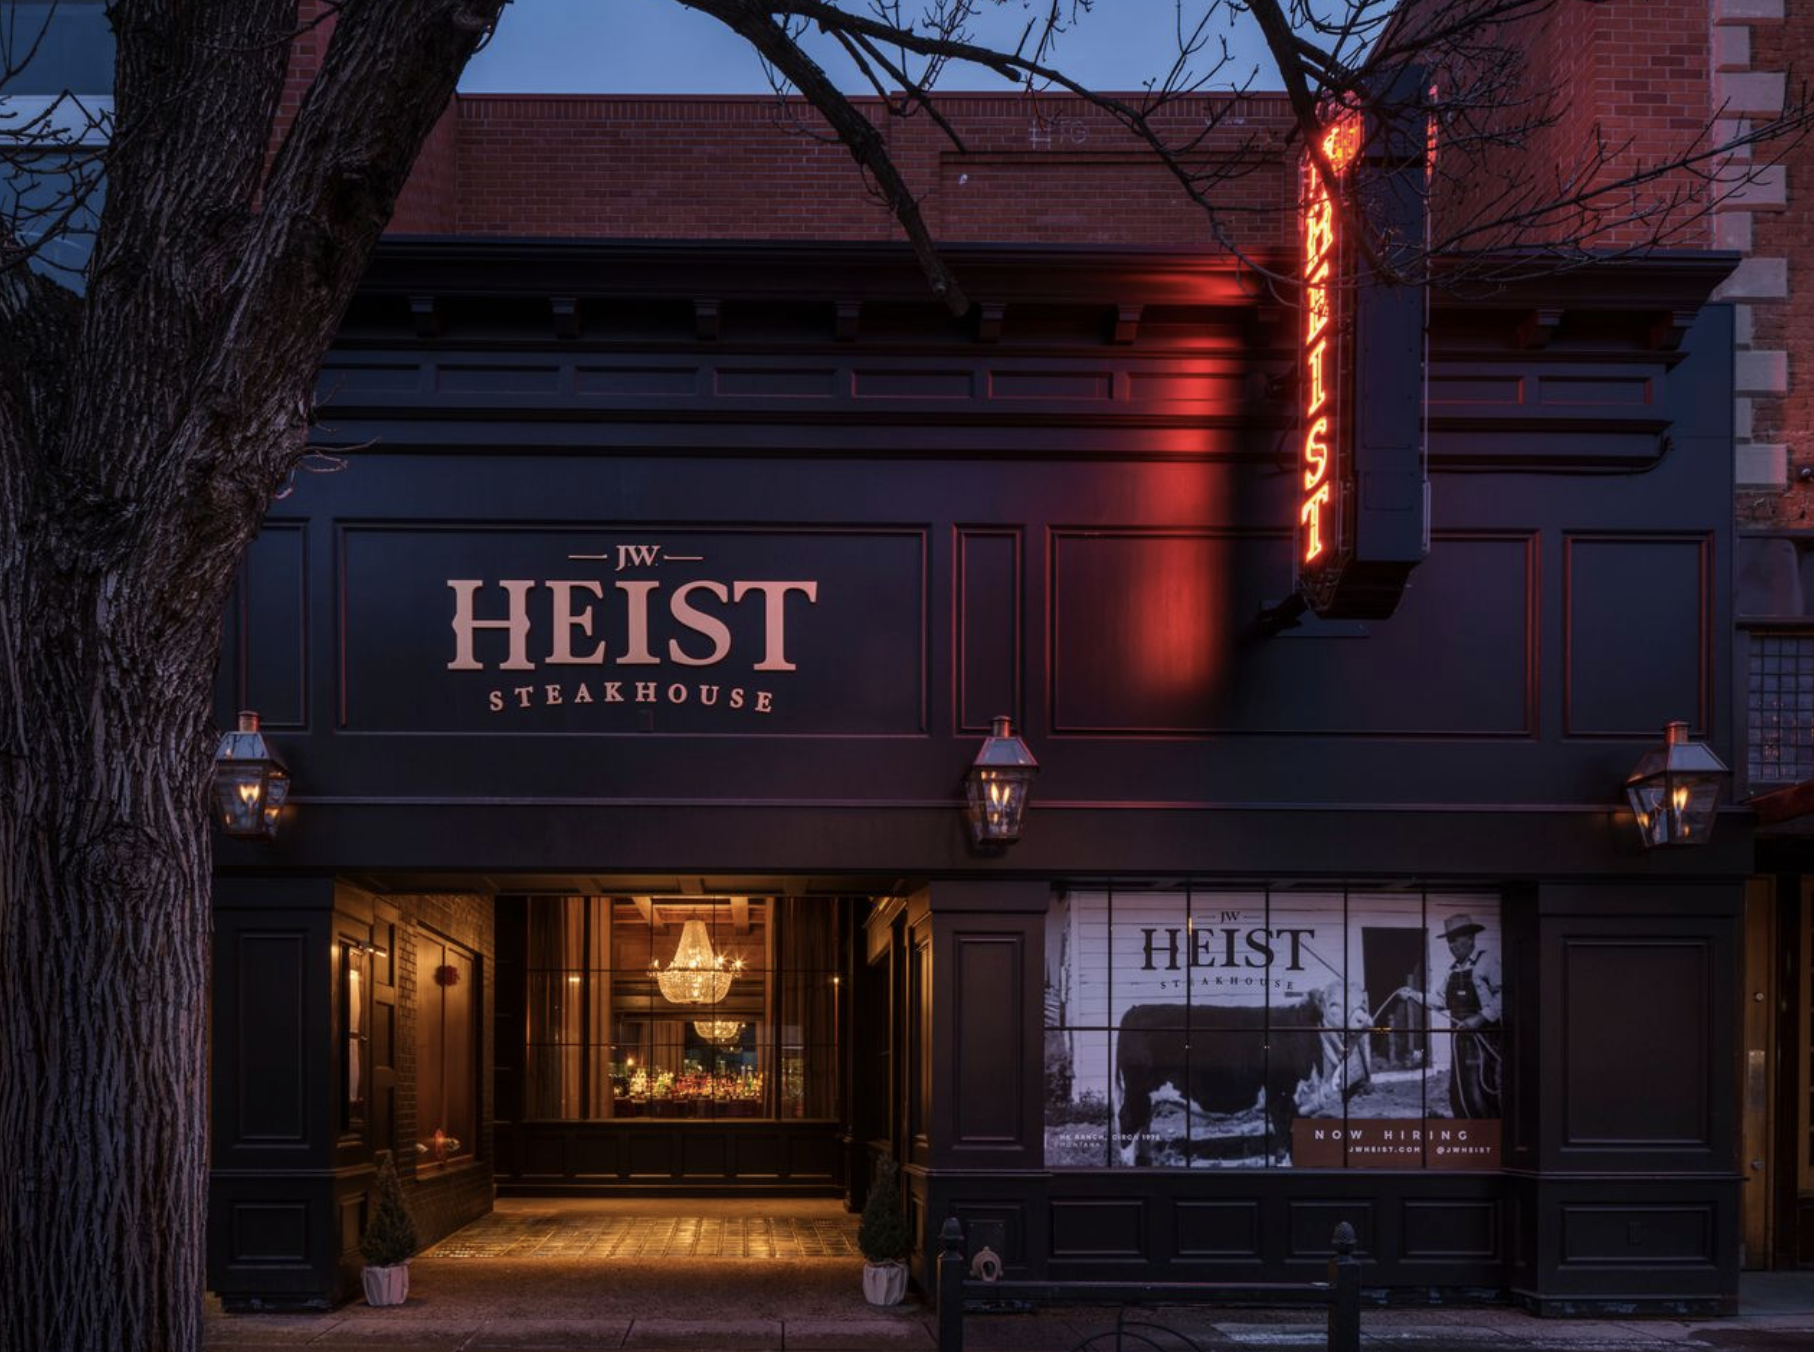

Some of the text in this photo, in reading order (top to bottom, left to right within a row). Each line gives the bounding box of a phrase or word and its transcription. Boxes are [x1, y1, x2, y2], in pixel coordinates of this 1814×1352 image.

[447, 579, 818, 671] HEIST
[489, 682, 773, 713] STEAKHOUSE
[1141, 928, 1316, 970] HEIST
[1314, 1129, 1468, 1141] NOW HIRING
[1436, 1145, 1491, 1155] @JWHEIST
